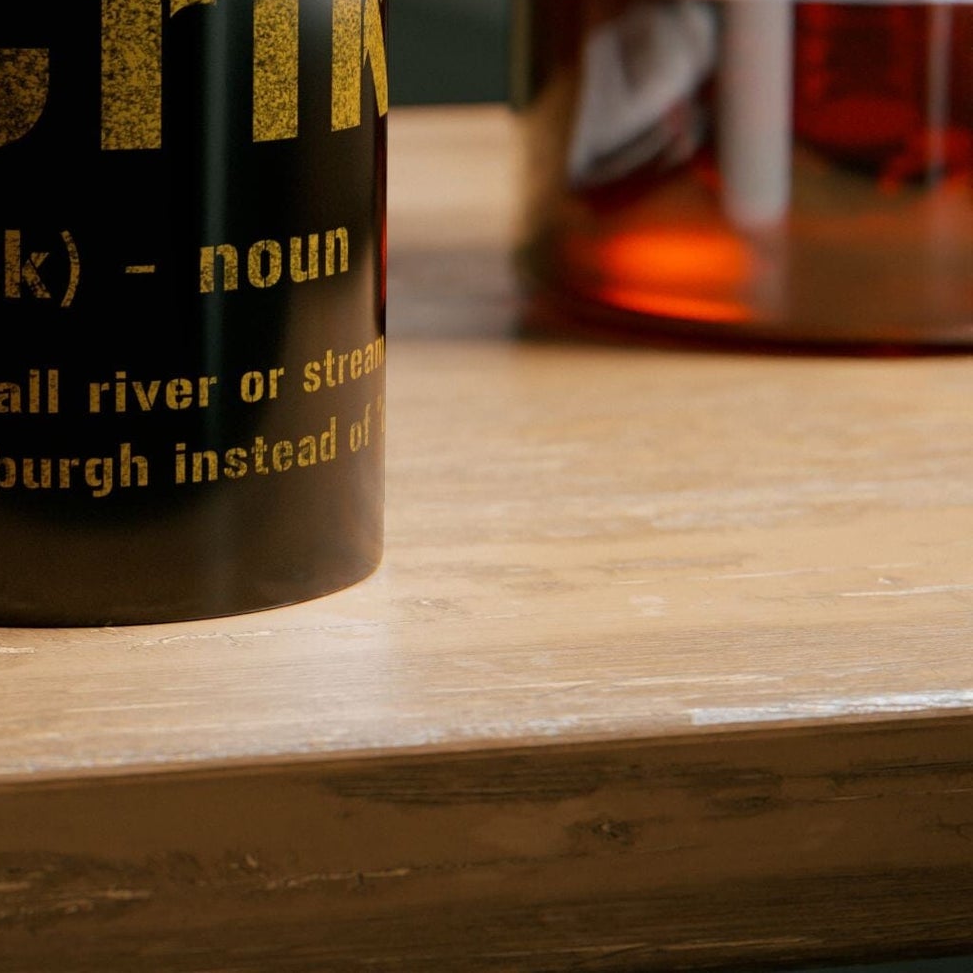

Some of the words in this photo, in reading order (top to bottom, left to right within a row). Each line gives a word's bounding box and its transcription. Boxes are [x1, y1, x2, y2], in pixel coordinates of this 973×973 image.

[199, 226, 350, 294] noun
[89, 371, 218, 413] river
[240, 365, 285, 403] or
[175, 416, 337, 483] instead
[349, 403, 371, 452] of
